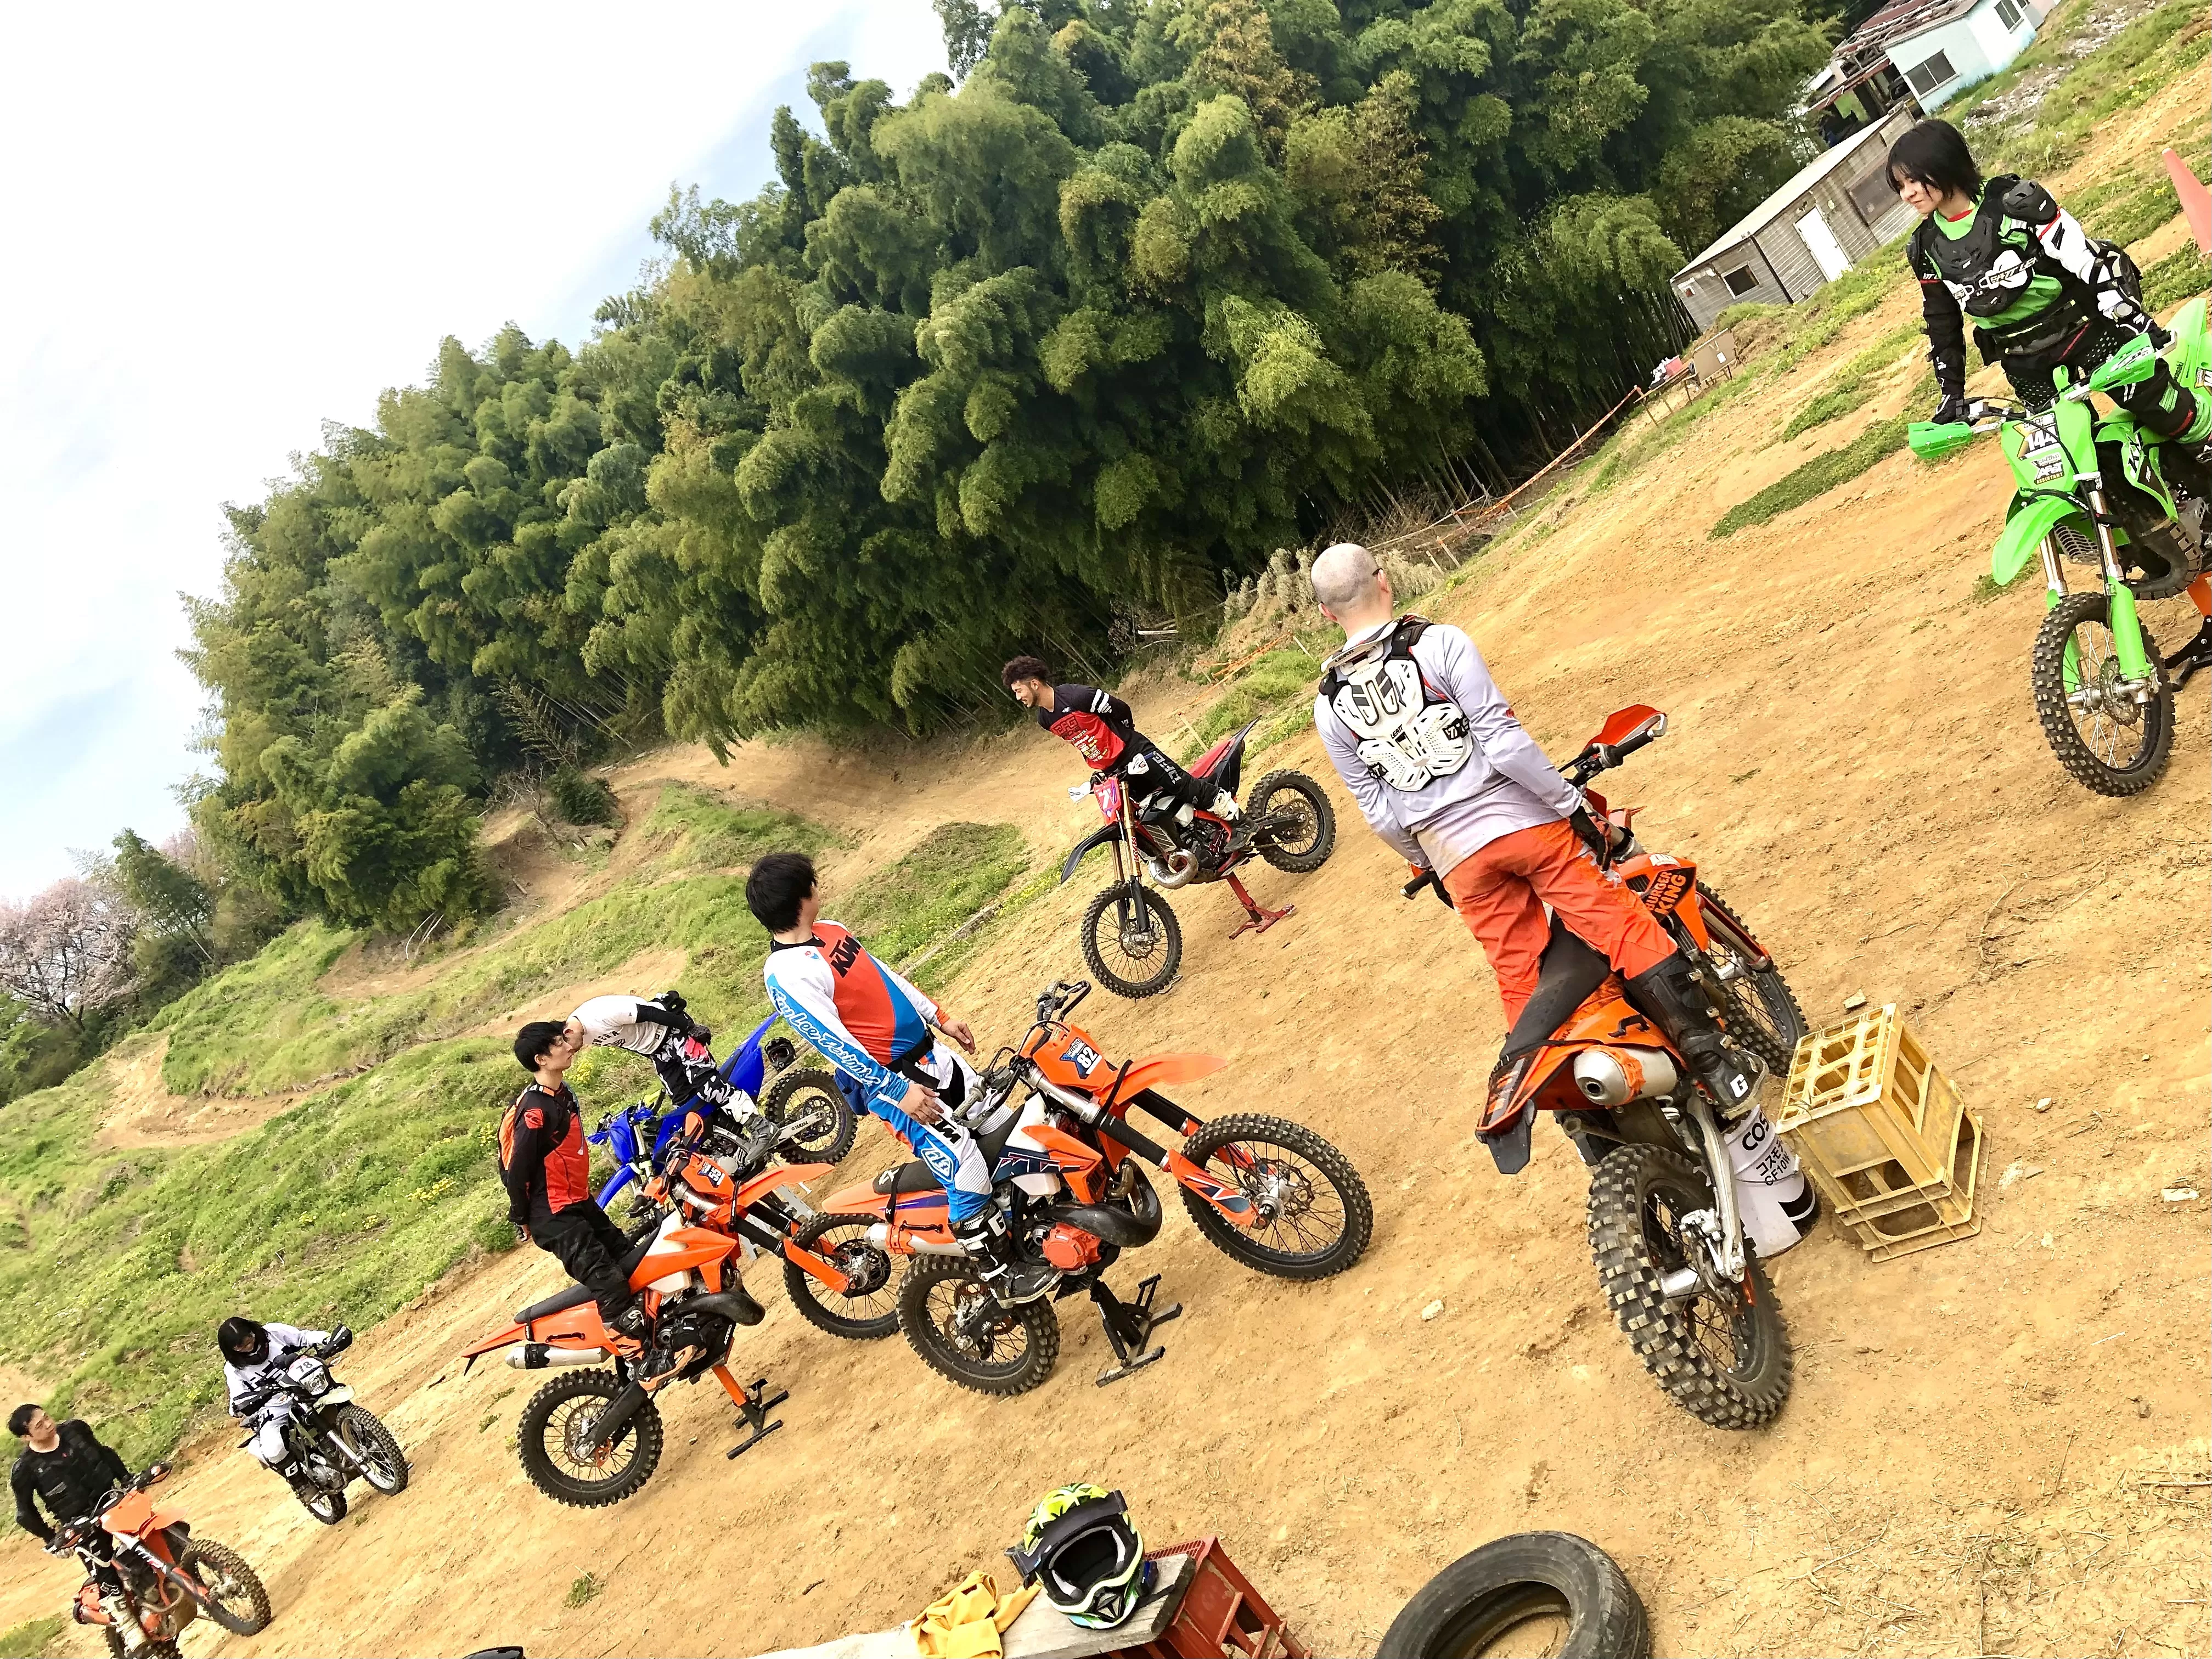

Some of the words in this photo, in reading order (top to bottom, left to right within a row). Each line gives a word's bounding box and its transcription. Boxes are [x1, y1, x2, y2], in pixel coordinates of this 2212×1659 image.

[1391, 724, 1403, 739] LEATT
[1645, 871, 1672, 911] BURGER
[1654, 874, 1686, 915] KING
[829, 935, 862, 978] KTM
[1067, 1039, 1081, 1056] CROSS
[1077, 1047, 1098, 1068] 82
[1730, 1073, 1749, 1098] G
[795, 1121, 808, 1129] YAMAHA
[708, 1167, 722, 1182] 55
[296, 1361, 313, 1373] 78
[285, 1461, 298, 1477] G
